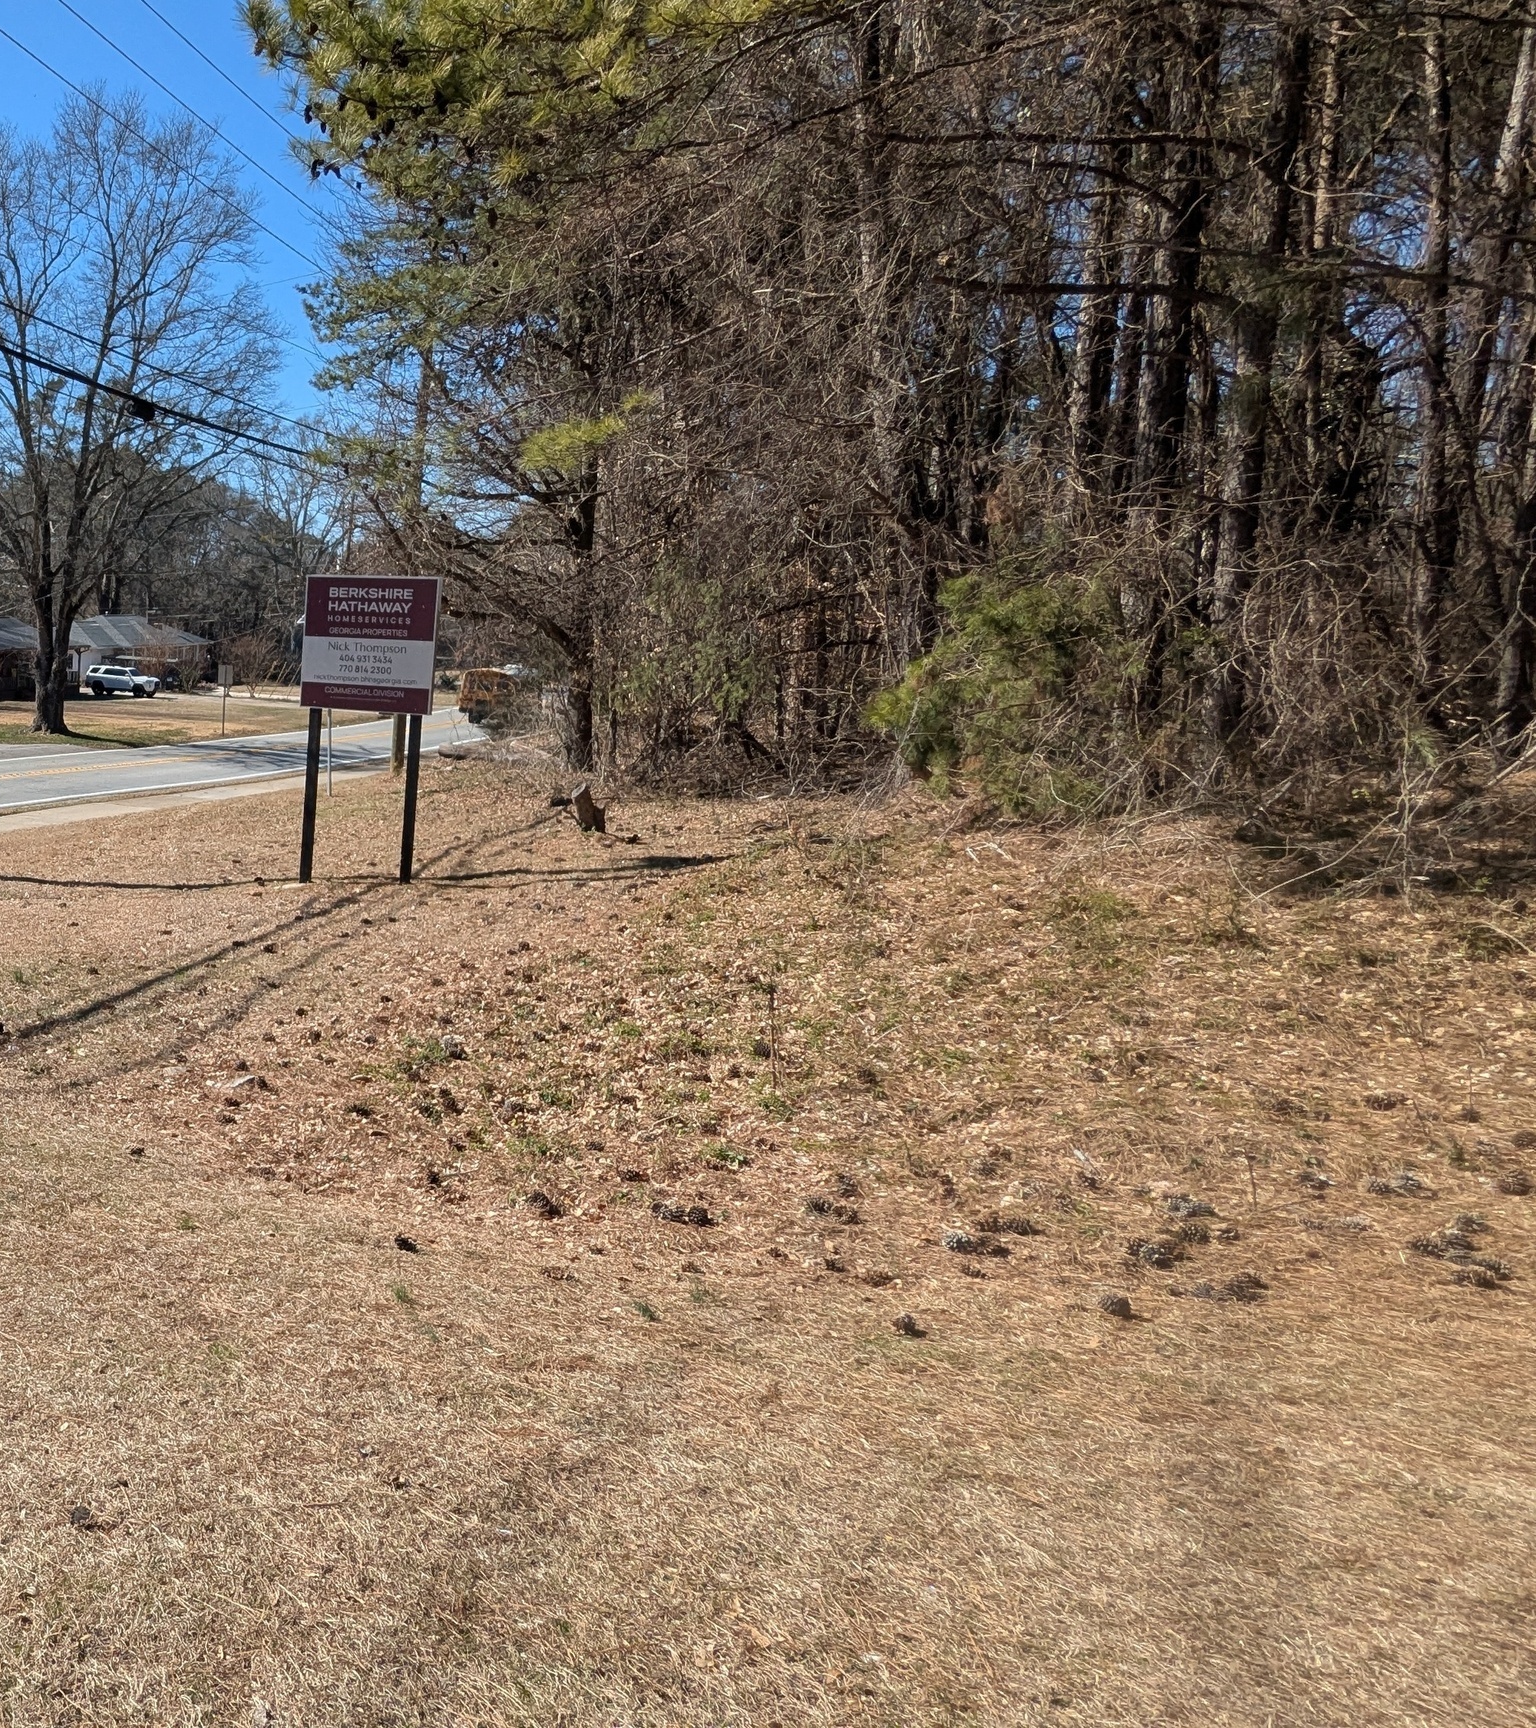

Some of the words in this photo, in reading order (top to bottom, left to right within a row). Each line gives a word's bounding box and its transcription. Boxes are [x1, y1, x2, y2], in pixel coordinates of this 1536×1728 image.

[329, 587, 414, 600] BERKSHIRE
[328, 600, 412, 614] HATHAWAY
[327, 614, 411, 625] HOMESERVICES
[329, 627, 361, 635] GEORGIA
[362, 628, 408, 637] PROPERTIES
[328, 641, 350, 651] Nick
[355, 642, 407, 655] Thompson
[339, 654, 355, 662] 404
[356, 655, 370, 663] 931
[372, 656, 393, 664] 3434
[339, 665, 353, 673] 770
[354, 666, 369, 674] 814
[370, 666, 392, 675] 2300
[324, 686, 372, 696] COMMERCIAL
[373, 689, 404, 698] DIVISION
